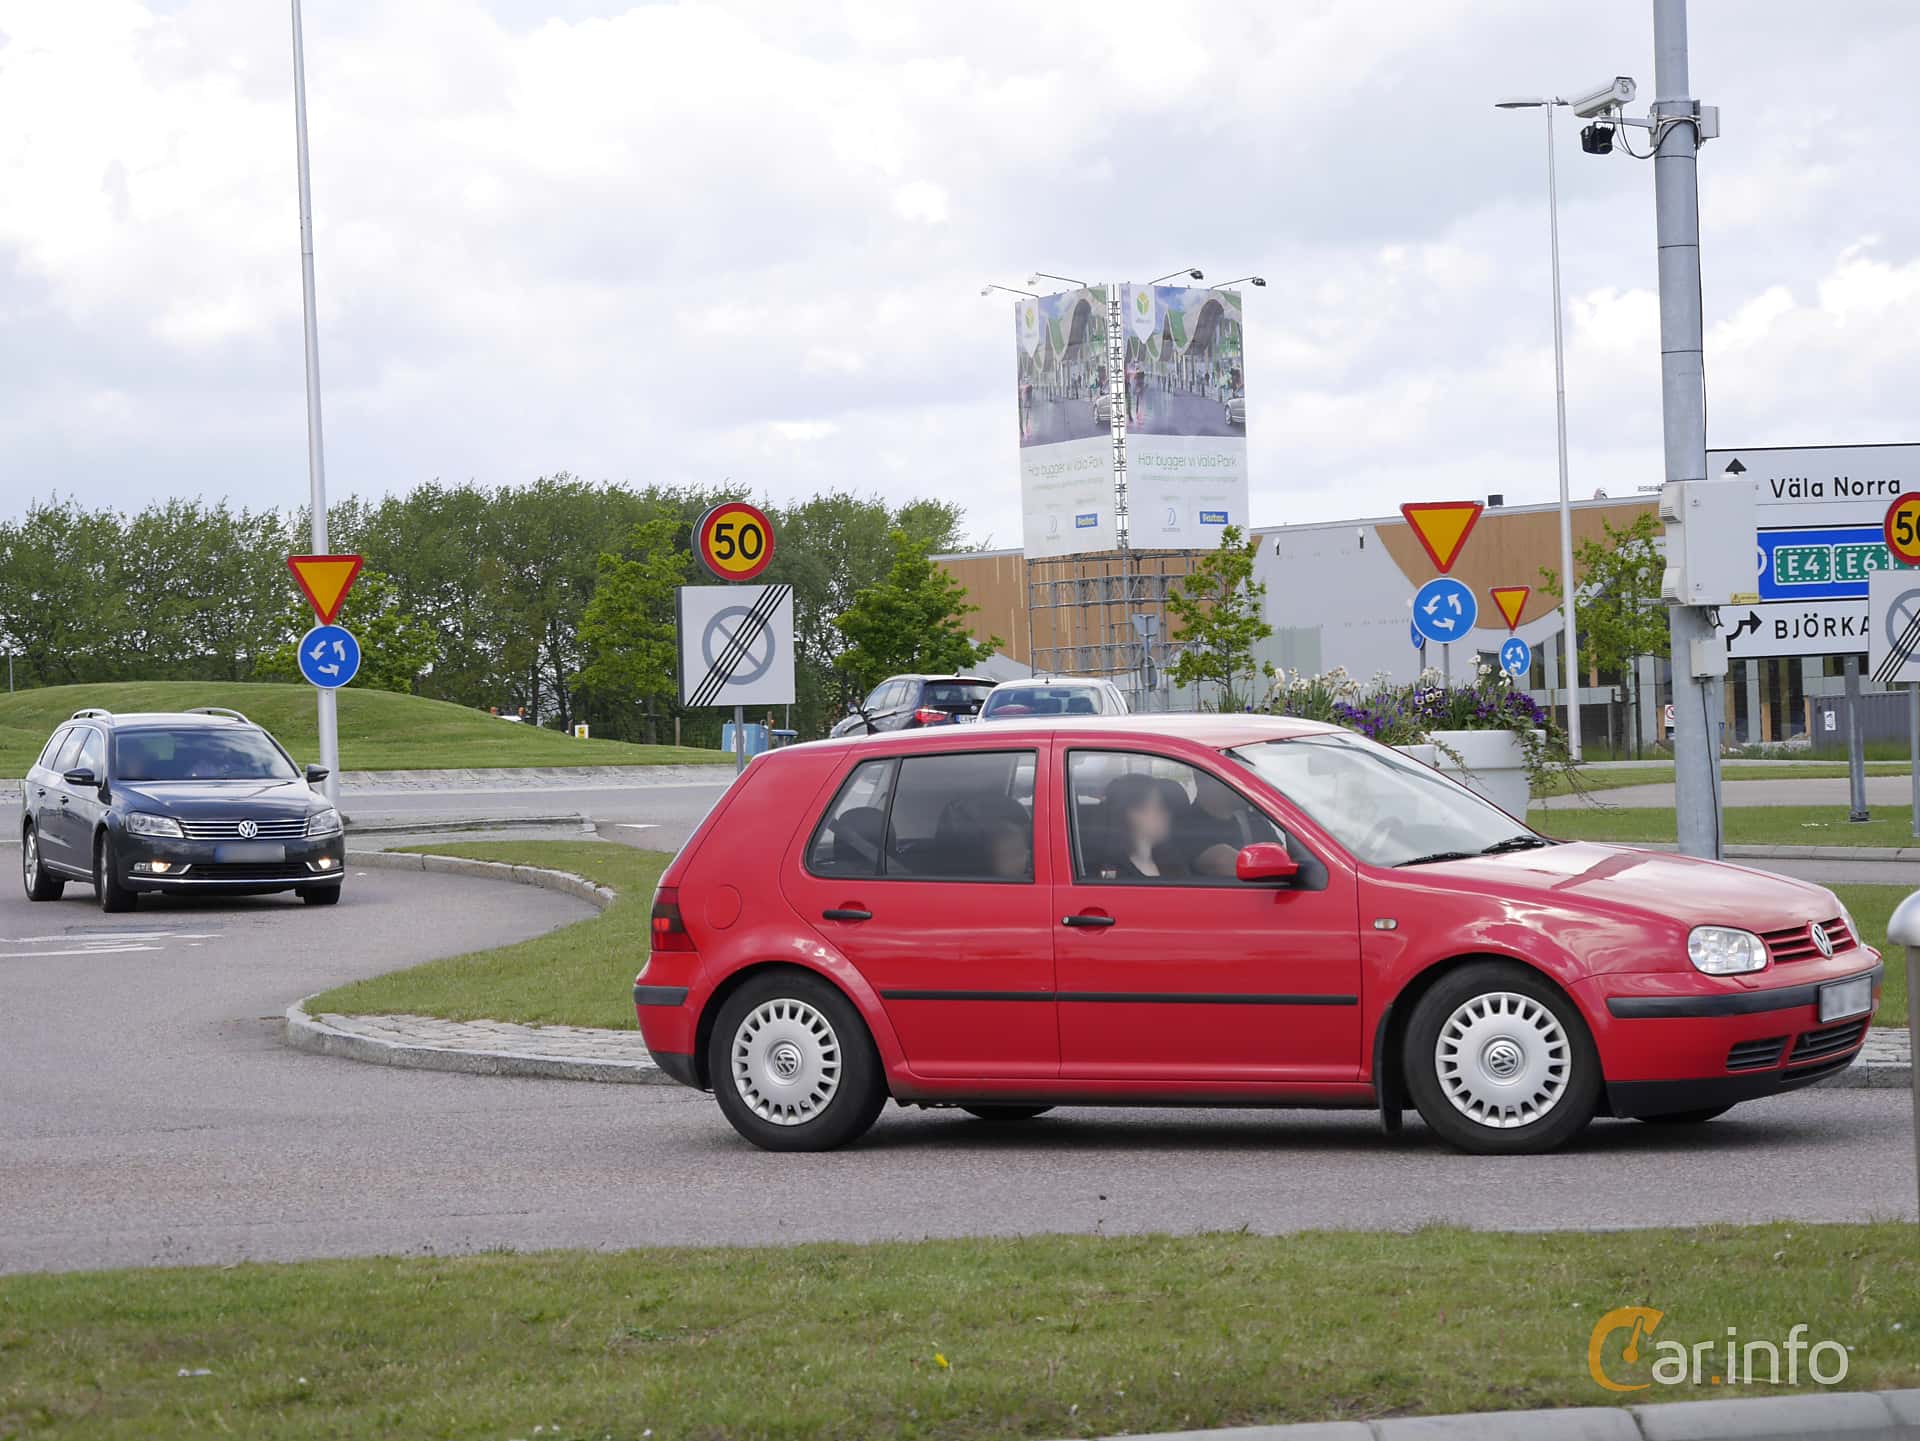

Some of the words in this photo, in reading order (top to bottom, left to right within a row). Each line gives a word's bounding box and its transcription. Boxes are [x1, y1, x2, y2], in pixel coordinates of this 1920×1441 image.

[1769, 478, 1824, 499] Väla
[1834, 476, 1901, 497] Norra
[714, 523, 763, 561] 50
[1896, 511, 1920, 546] 5
